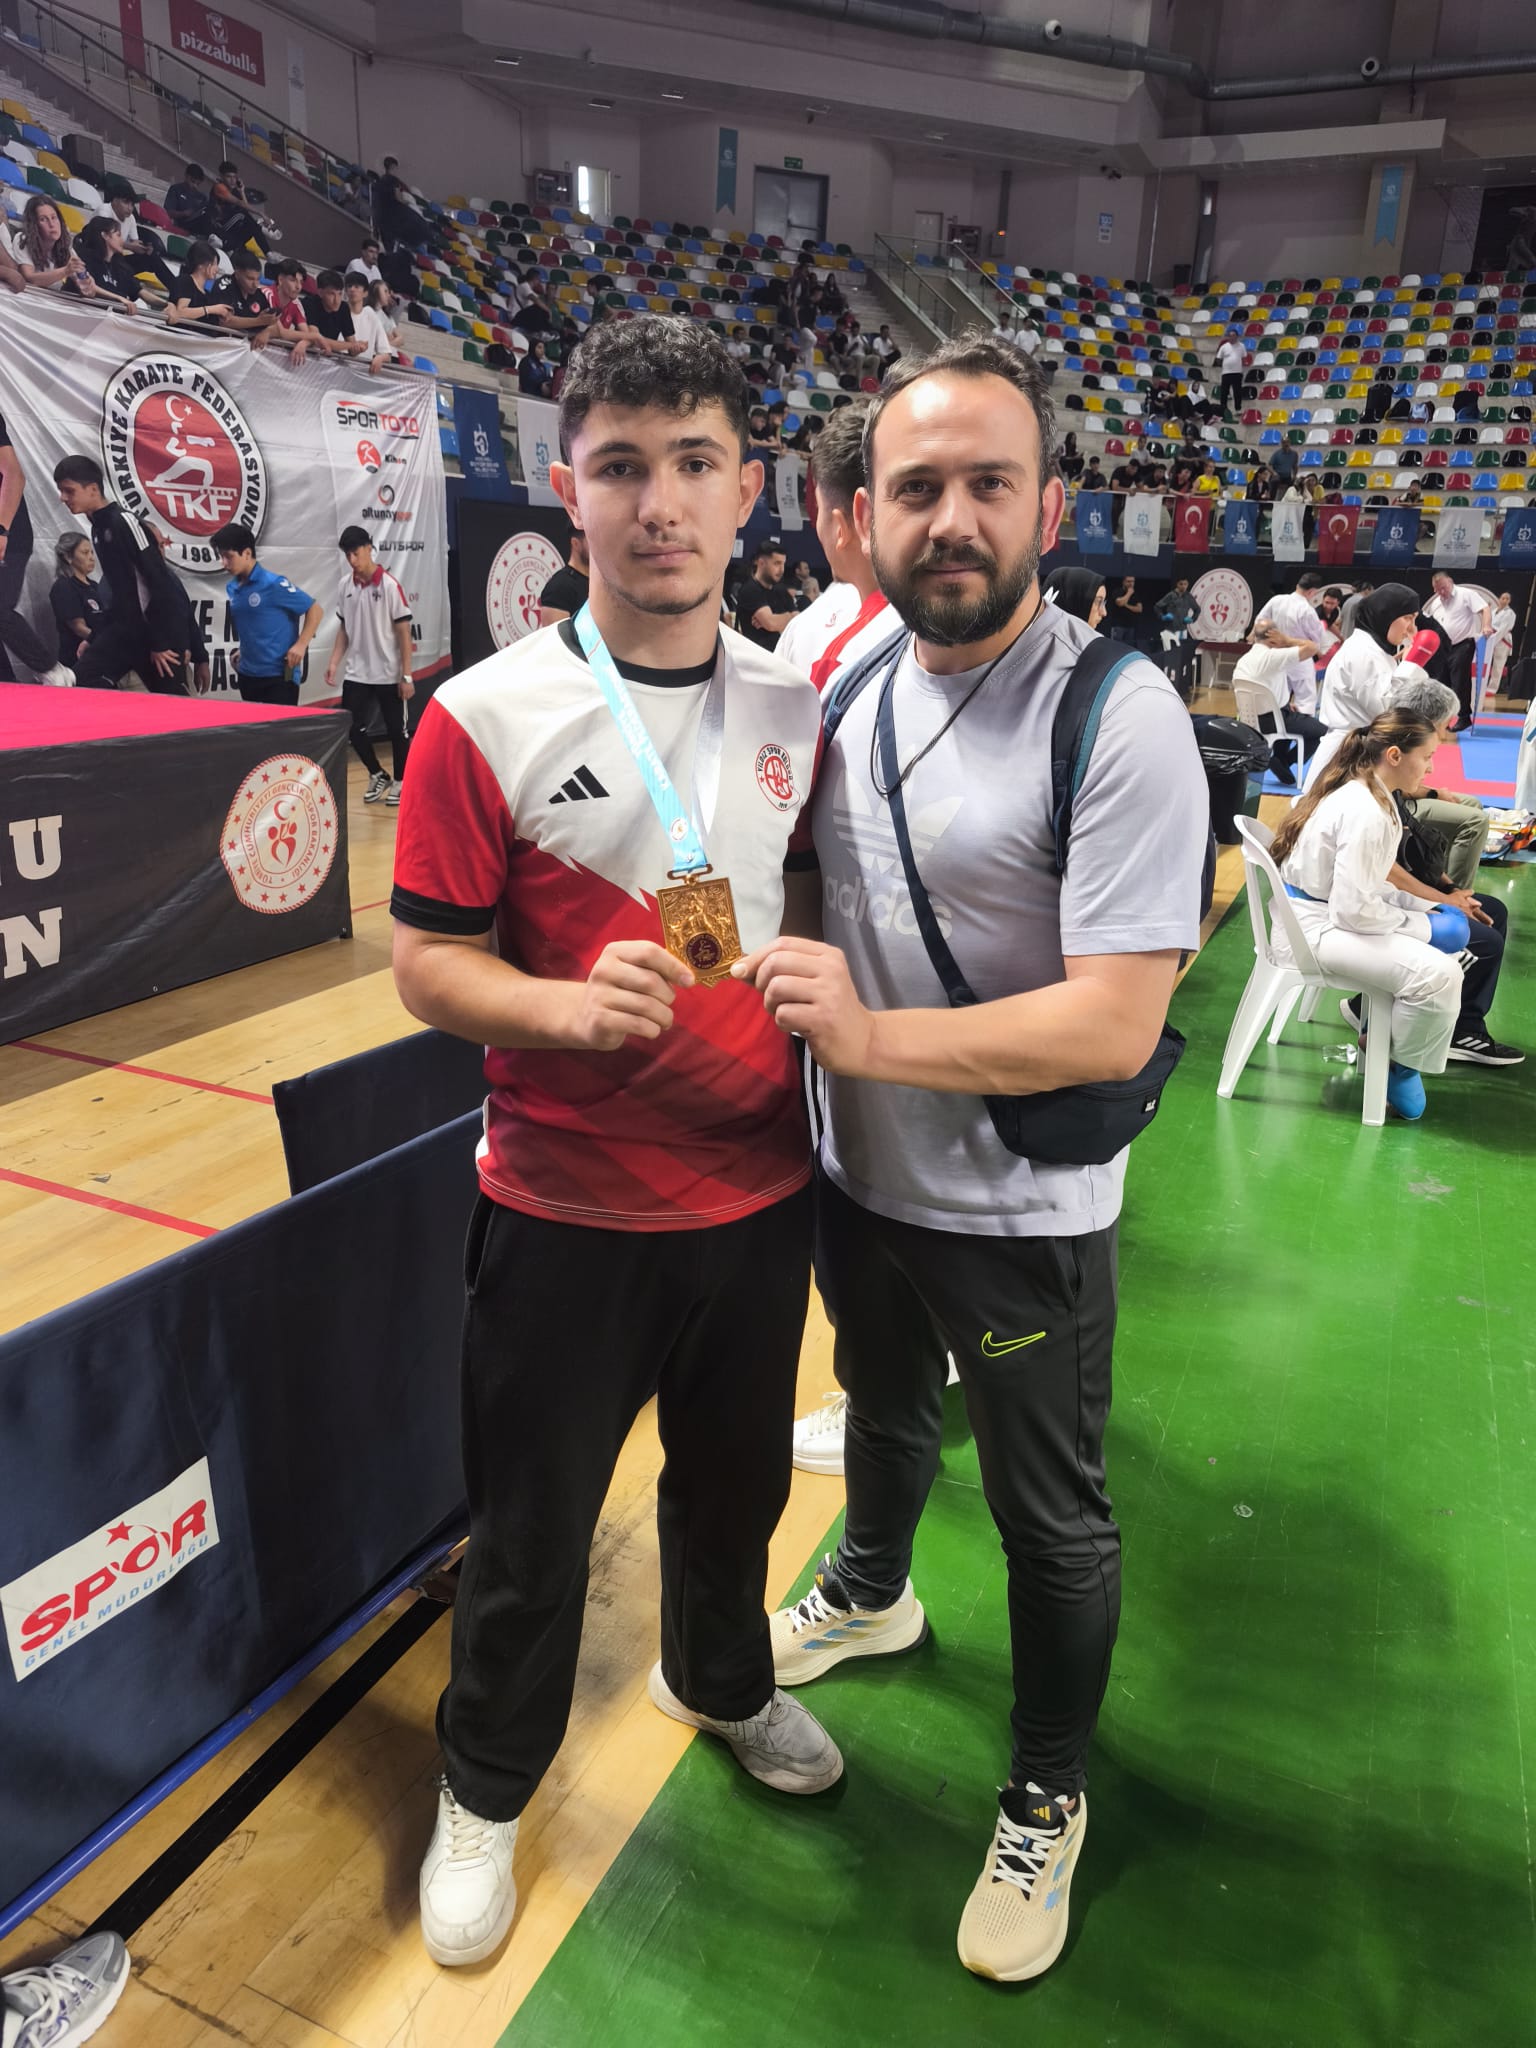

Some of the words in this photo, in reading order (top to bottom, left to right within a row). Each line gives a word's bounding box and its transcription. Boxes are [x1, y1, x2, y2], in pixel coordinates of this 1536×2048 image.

[180, 31, 257, 75] pizzabulls
[114, 363, 184, 411] KARATE
[191, 373, 260, 531] FEDERASYONU
[155, 489, 233, 521] TKF
[0, 815, 63, 886] U
[825, 875, 953, 939] adidas
[20, 1499, 208, 1652] SPOR
[24, 1620, 88, 1669] GENEL
